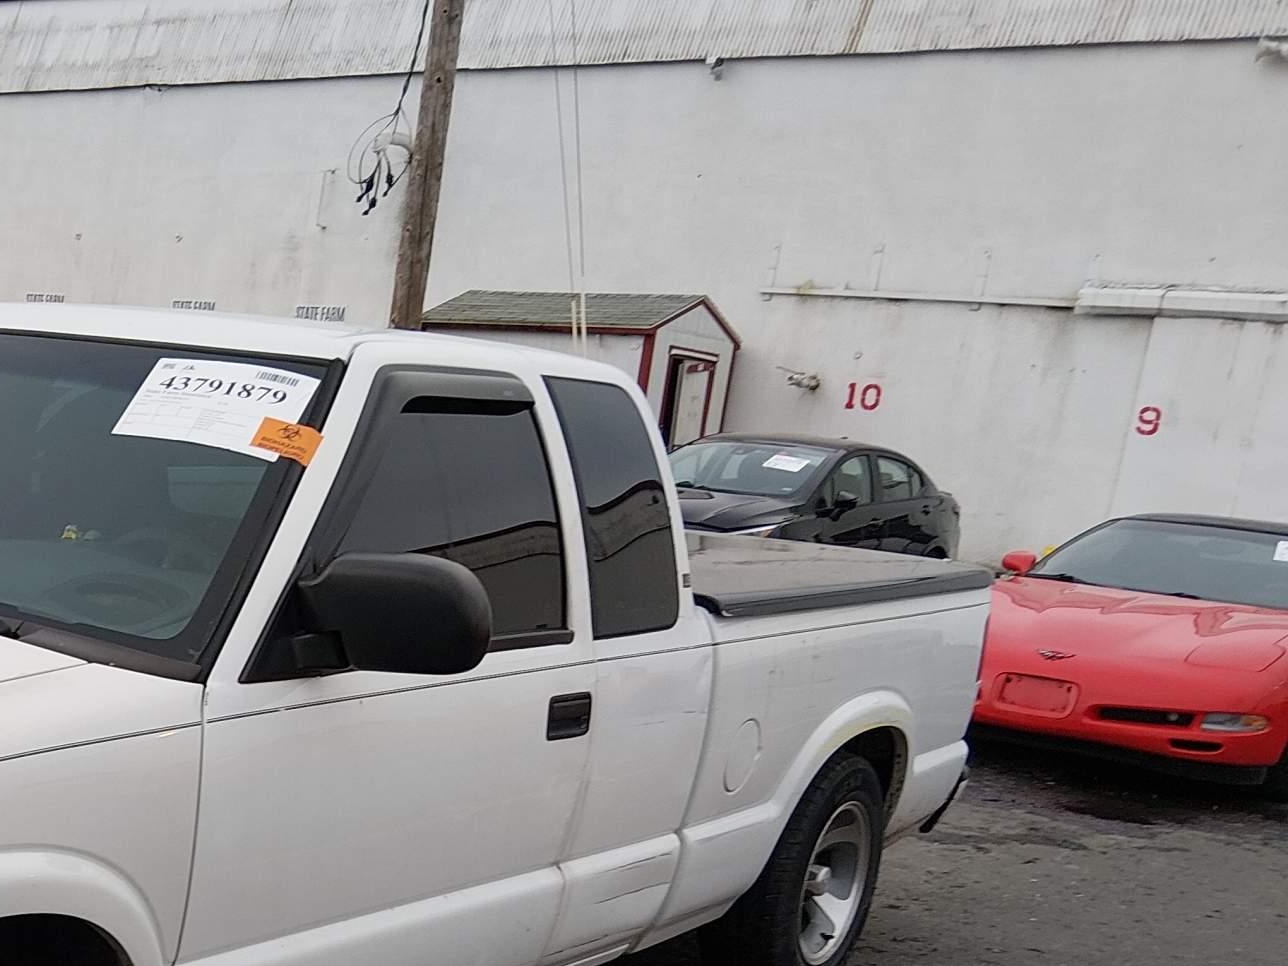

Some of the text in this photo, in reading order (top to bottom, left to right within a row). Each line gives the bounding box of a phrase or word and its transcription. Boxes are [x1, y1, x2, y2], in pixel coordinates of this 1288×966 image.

[296, 306, 345, 321] STATE FARM
[159, 375, 288, 405] 43791879
[844, 382, 882, 411] 10
[1135, 406, 1162, 436] 9
